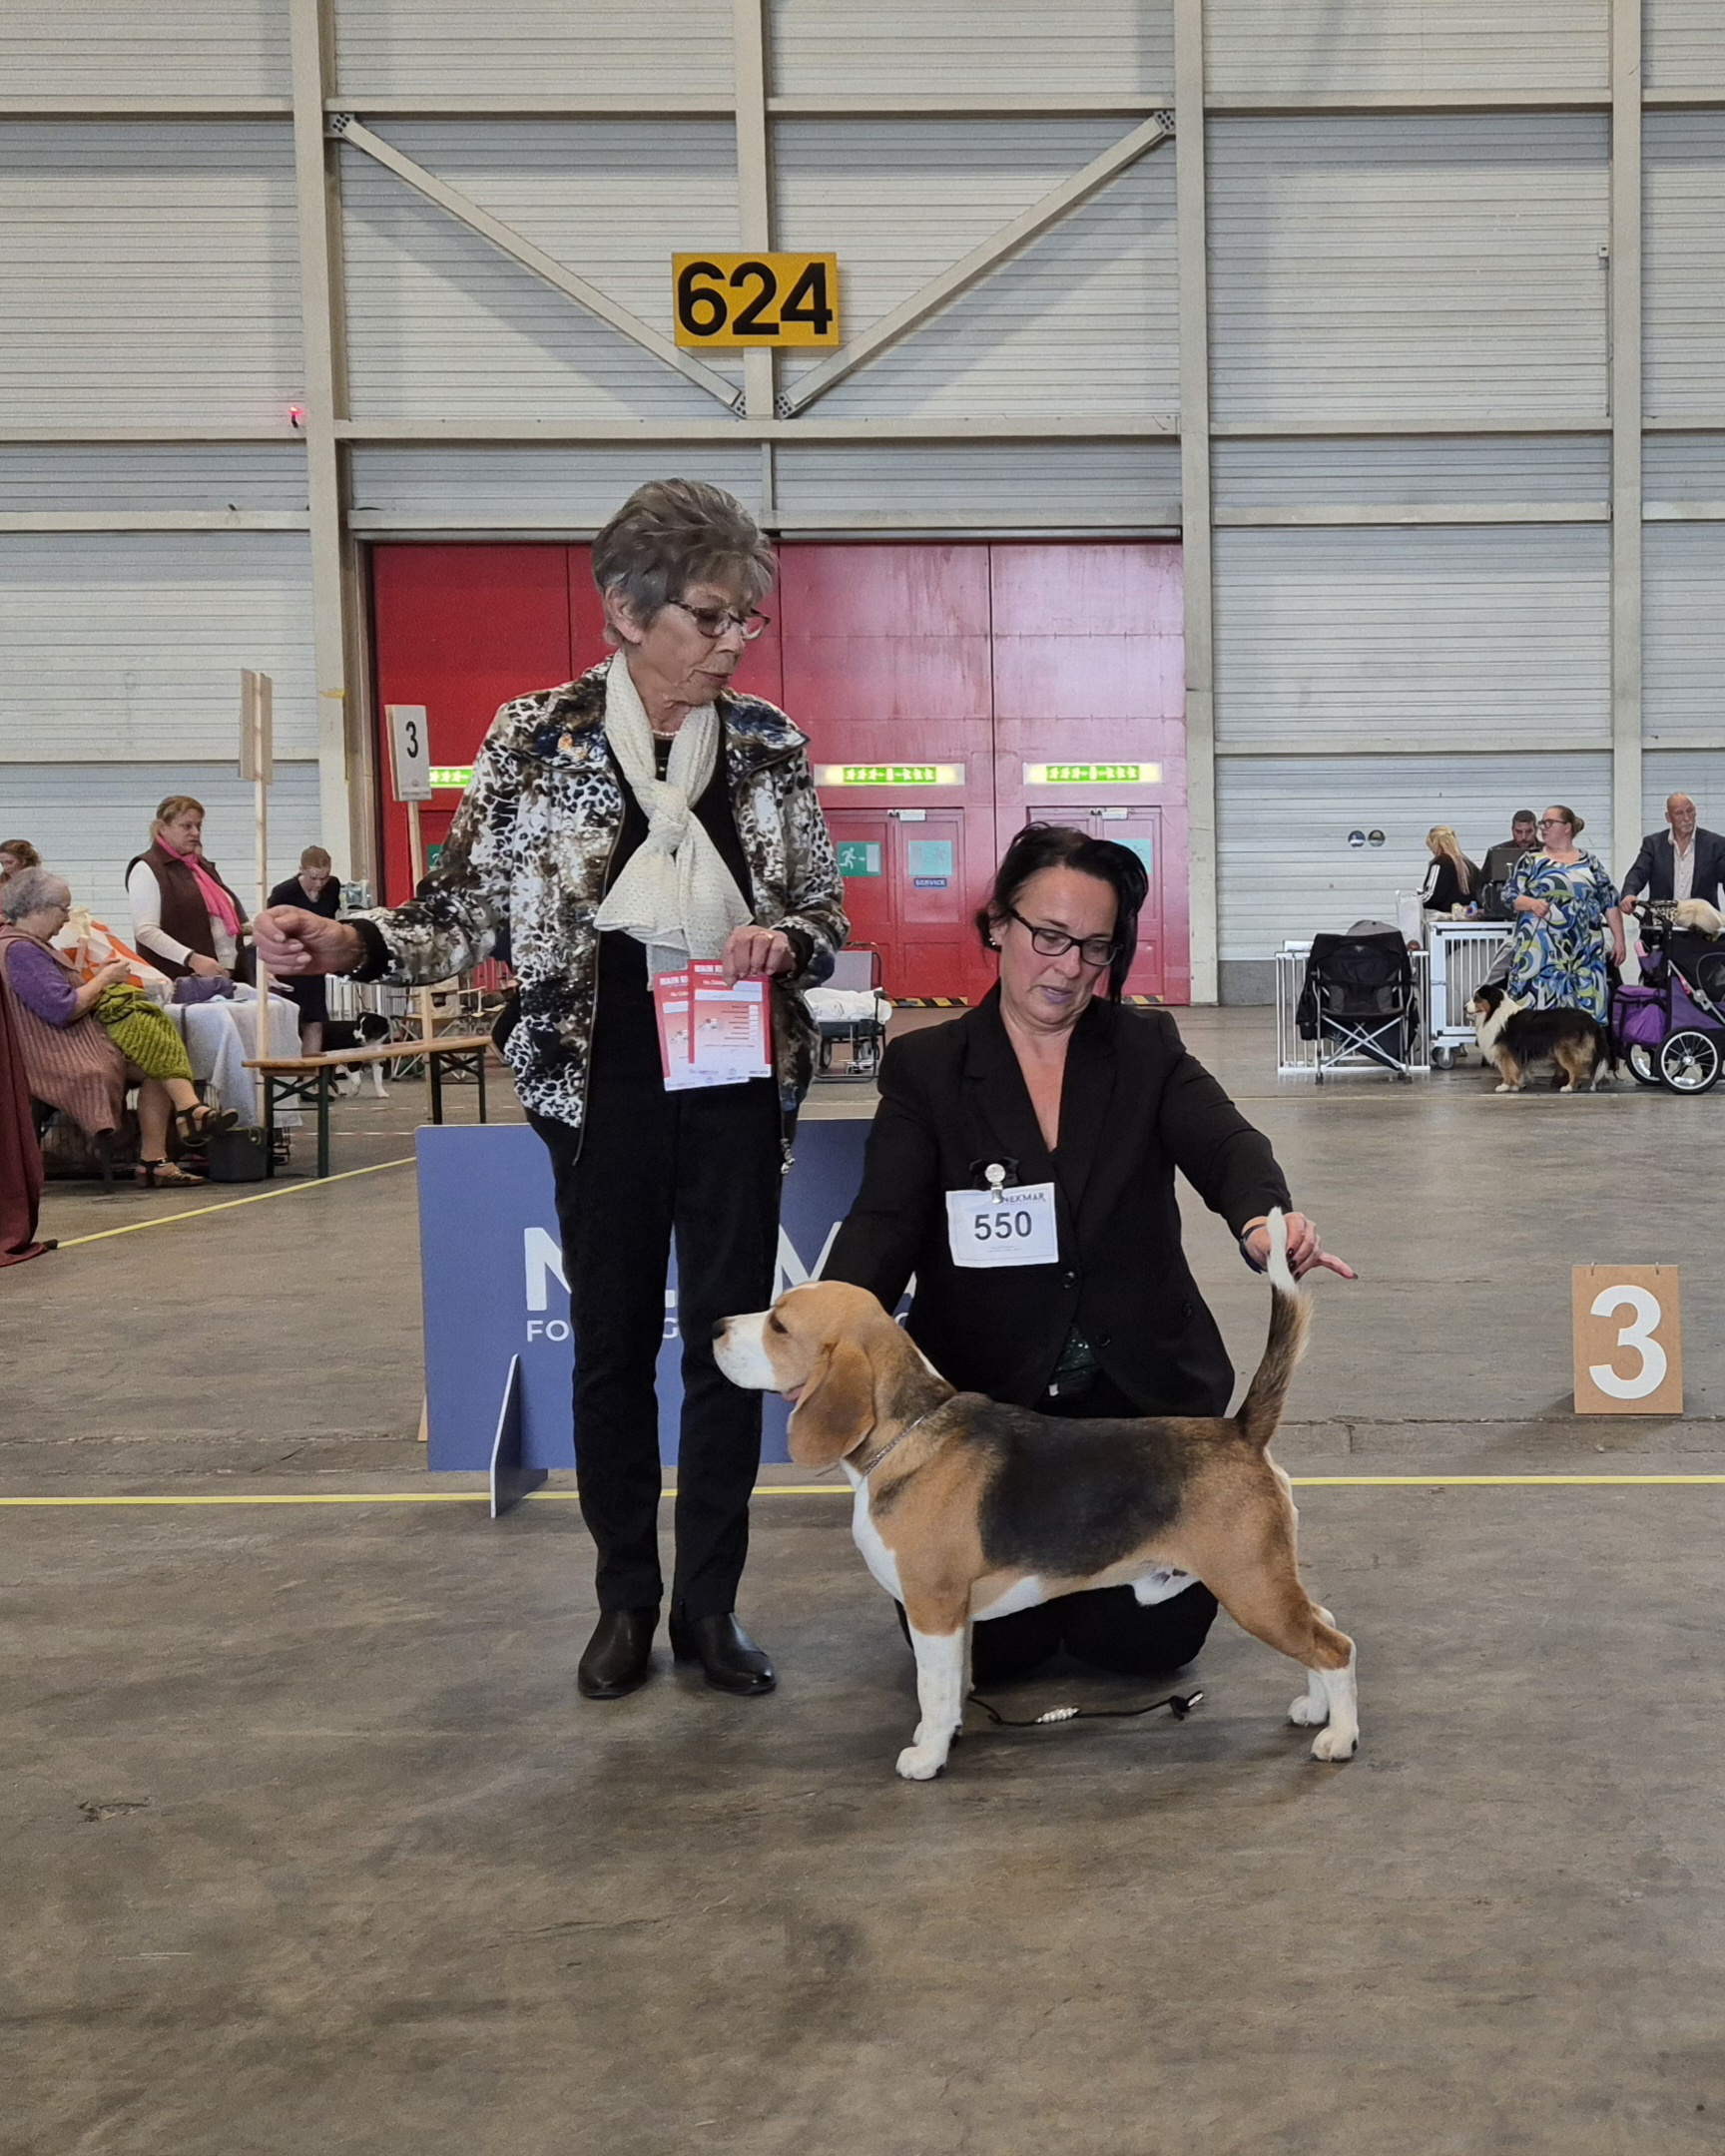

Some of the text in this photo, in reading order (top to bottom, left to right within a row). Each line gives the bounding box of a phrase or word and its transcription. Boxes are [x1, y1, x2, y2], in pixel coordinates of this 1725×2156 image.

[678, 261, 834, 336] 624
[405, 721, 419, 759] 3
[973, 1210, 1032, 1241] 550
[1588, 1284, 1668, 1400] 3
